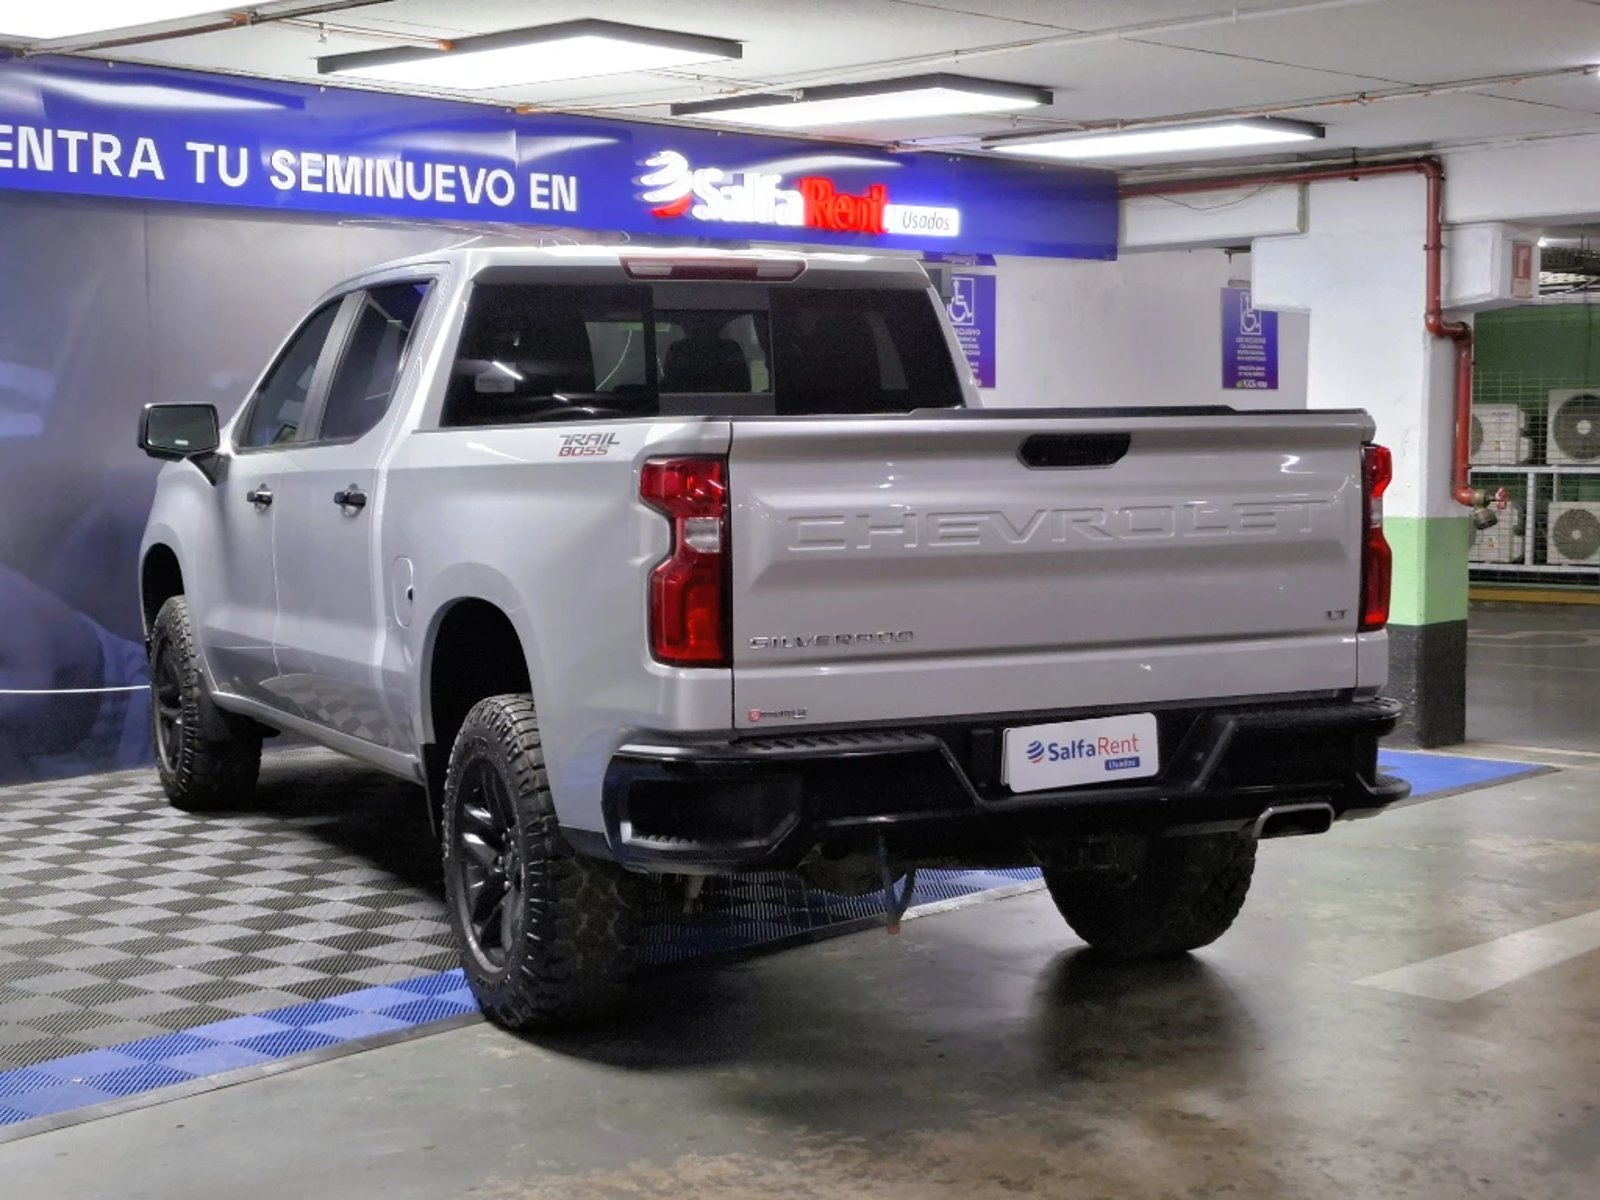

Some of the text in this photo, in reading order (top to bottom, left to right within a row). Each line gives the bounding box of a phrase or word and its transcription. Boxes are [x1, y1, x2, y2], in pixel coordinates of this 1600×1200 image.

[0, 124, 577, 212] ENTRA TU SEMINUEVO EN
[901, 210, 950, 232] Usados
[559, 432, 620, 446] TRAIL
[558, 446, 609, 457] BOSS
[787, 499, 1331, 552] CHEVROLET
[1325, 609, 1349, 621] LT
[749, 630, 914, 649] SILVERADO
[1048, 734, 1139, 762] SalfaRent
[1108, 757, 1137, 769] Usados
